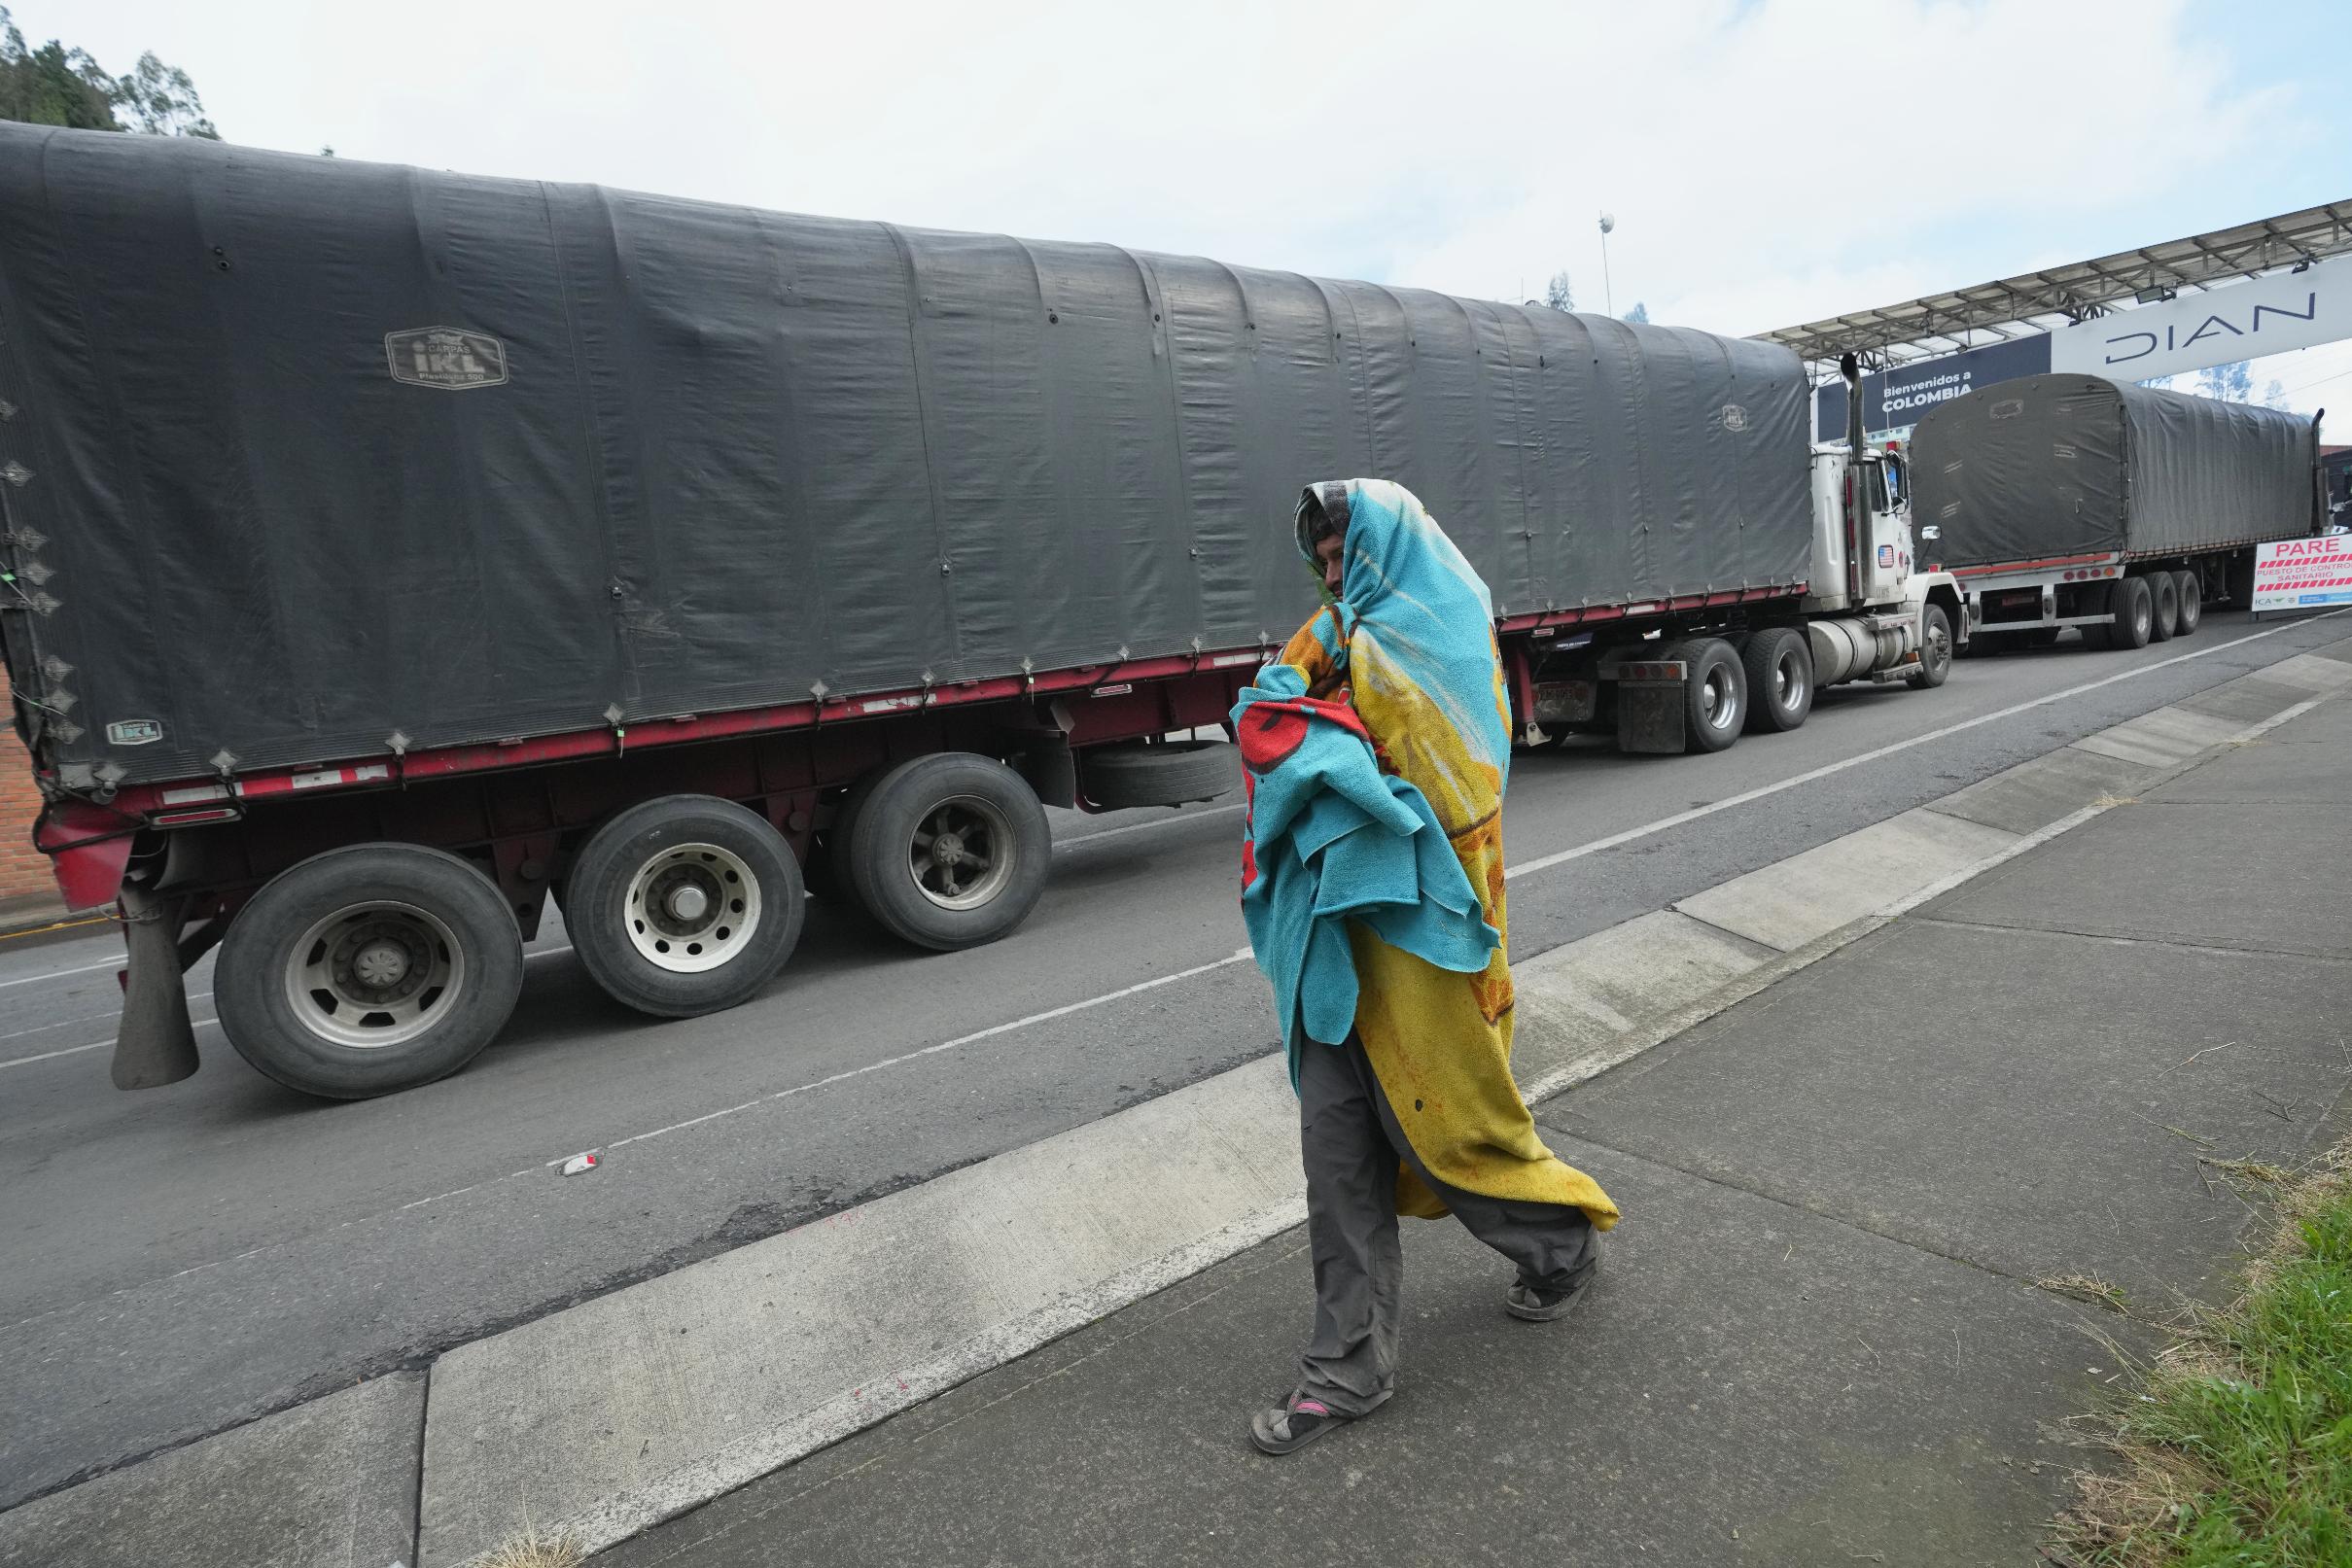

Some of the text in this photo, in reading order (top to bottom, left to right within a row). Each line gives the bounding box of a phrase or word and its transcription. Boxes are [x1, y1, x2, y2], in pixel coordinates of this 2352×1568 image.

[2105, 292, 2316, 365] DIAN
[428, 344, 471, 354] CARPAS
[1883, 371, 1972, 398] Bienvenidos a
[1881, 383, 1972, 412] COLOMBIA
[2276, 538, 2340, 557] PARE
[2277, 572, 2334, 581] SANITARIO
[2310, 563, 2352, 572] CONTRO
